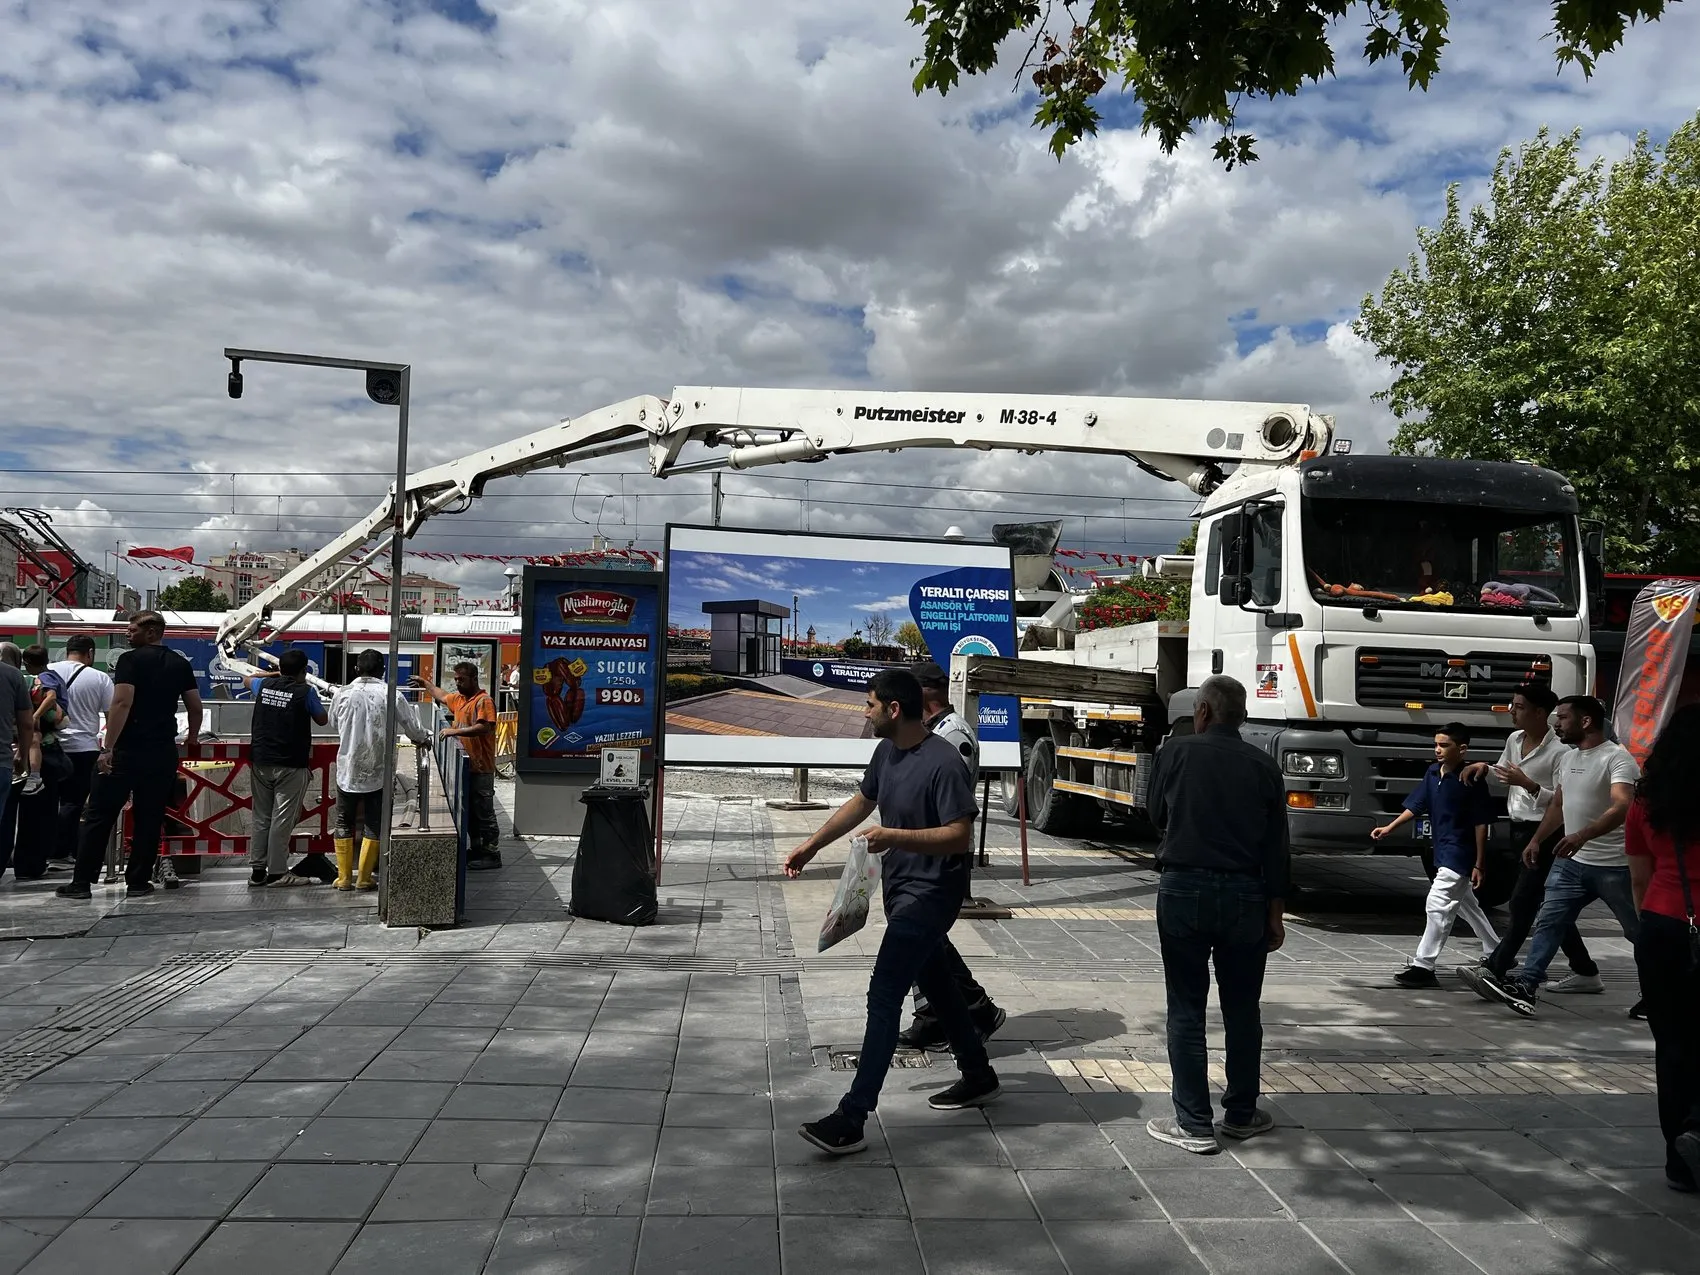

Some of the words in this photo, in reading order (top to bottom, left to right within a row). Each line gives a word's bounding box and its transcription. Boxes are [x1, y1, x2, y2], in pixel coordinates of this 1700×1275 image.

[854, 406, 966, 424] Putzmeister
[920, 586, 963, 599] YERALTI
[965, 588, 1009, 603] ÇARŞISI
[564, 595, 628, 616] Müslümoğlu
[920, 600, 962, 611] ASANSÖR
[963, 602, 975, 611] VE
[920, 610, 956, 620] ENGELLİ
[958, 612, 1009, 623] PLATFORMU
[920, 621, 948, 631] YAPIM
[950, 620, 961, 633] İŞİ
[543, 635, 567, 646] YAZ
[569, 636, 647, 648] KAMPANYASI
[597, 661, 646, 674] SUCUK
[831, 668, 859, 678] YERALTI
[1420, 663, 1491, 679] MAN
[595, 733, 615, 743] YAZIN
[616, 729, 642, 740] LEZZETİ
